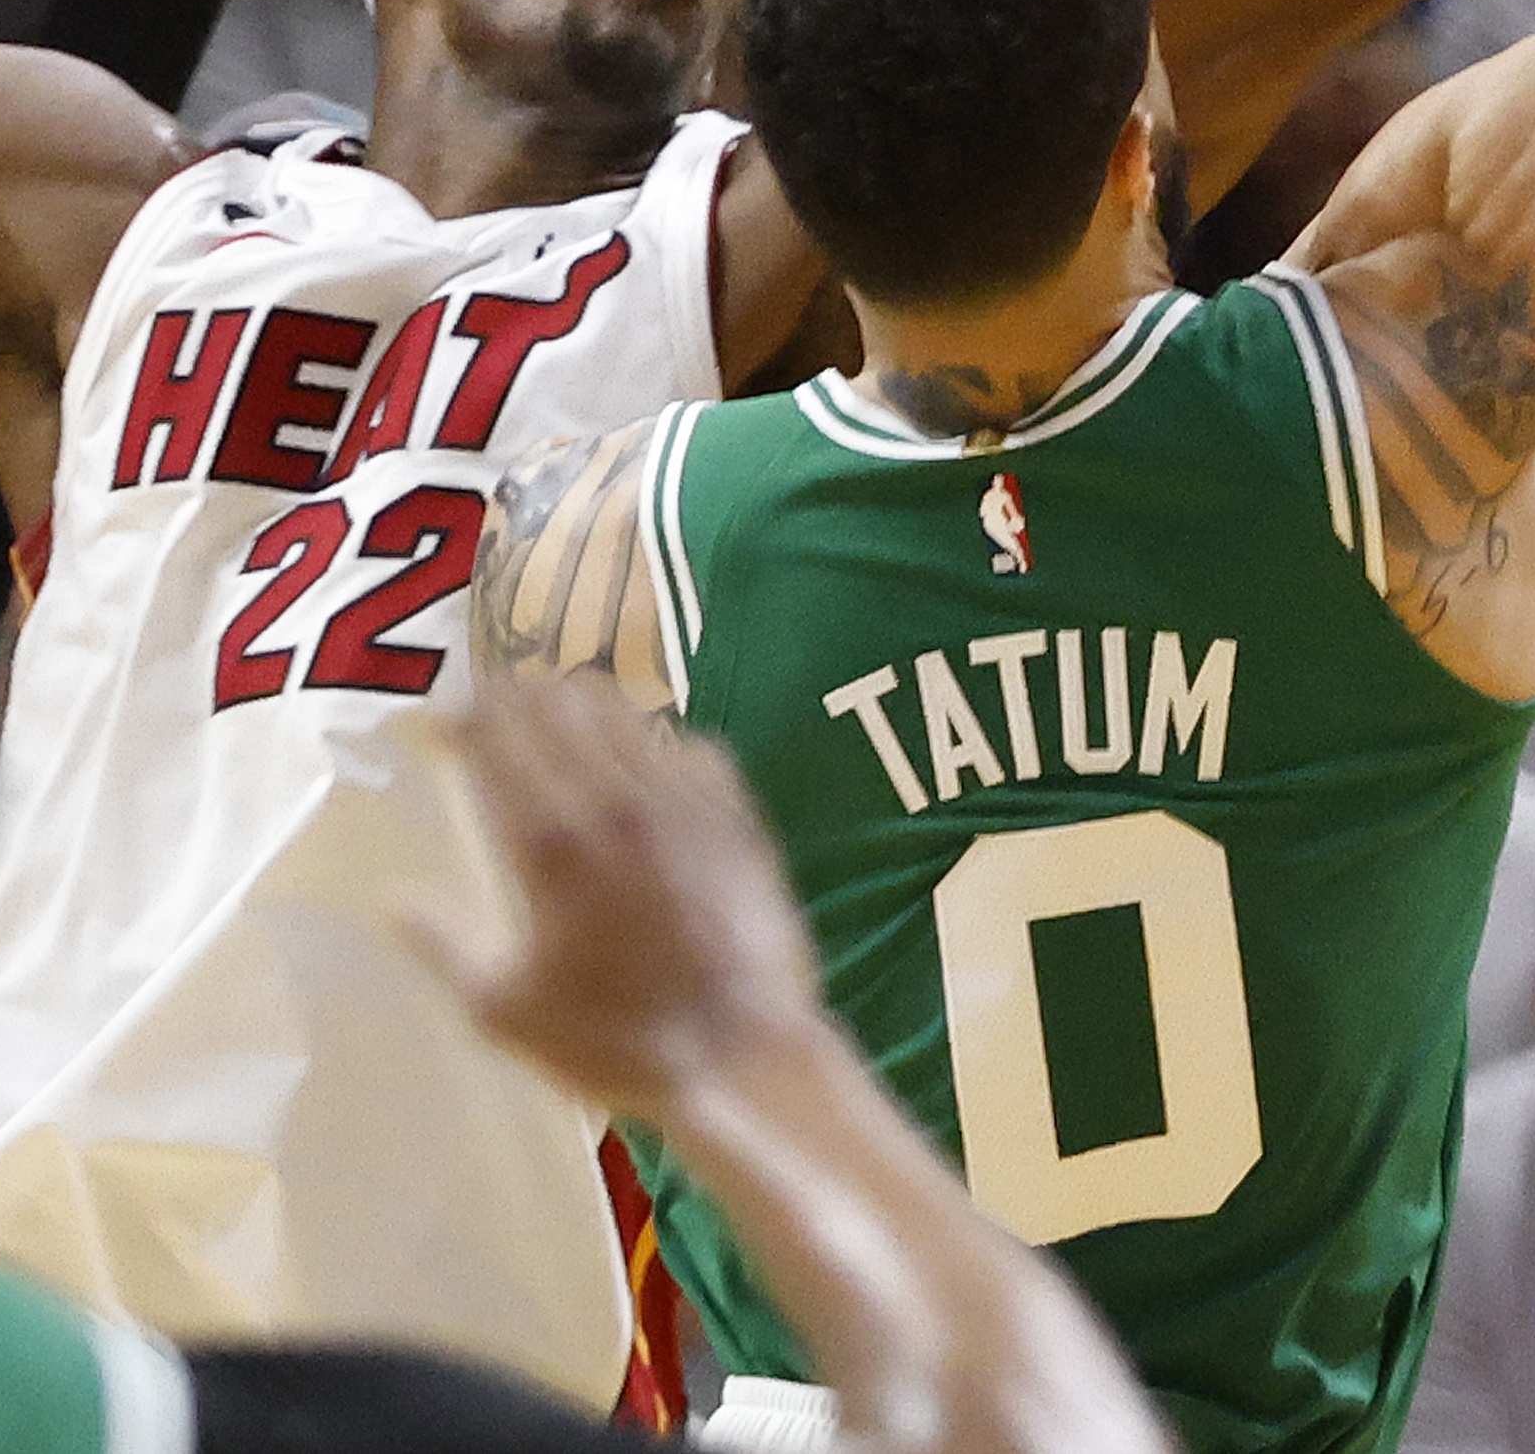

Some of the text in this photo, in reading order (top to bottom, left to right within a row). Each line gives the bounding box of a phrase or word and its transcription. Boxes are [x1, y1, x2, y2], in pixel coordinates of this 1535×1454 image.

[109, 230, 632, 494] HEAT
[212, 484, 486, 716] 22
[821, 625, 1239, 815] TATUM
[932, 810, 1264, 1249] 0
